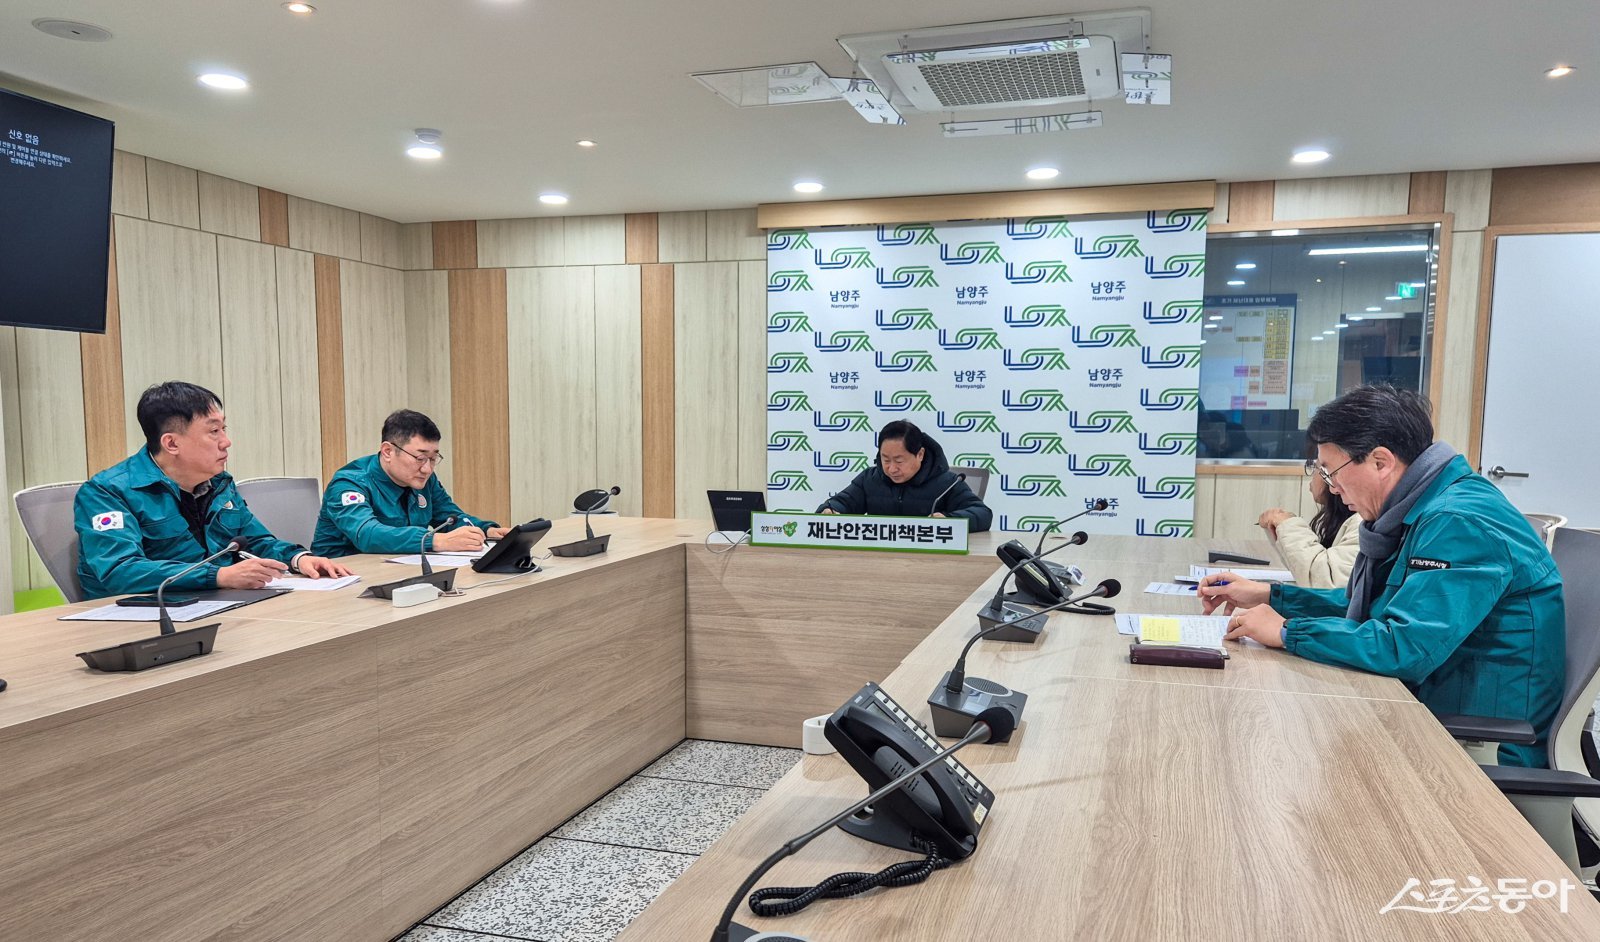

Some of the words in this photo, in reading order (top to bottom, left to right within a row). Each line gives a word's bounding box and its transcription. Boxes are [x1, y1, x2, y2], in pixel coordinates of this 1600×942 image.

[8, 129, 23, 140] 신호
[25, 133, 39, 146] 없음
[956, 286, 988, 298] 남양주
[1091, 281, 1127, 294] 남양주
[830, 290, 860, 302] 남양주
[829, 371, 860, 384] 남양주
[954, 370, 987, 383] 남양주
[1088, 368, 1124, 383] 남양주
[1084, 497, 1119, 510] 남주
[807, 521, 954, 543] 재난안전대책본부
